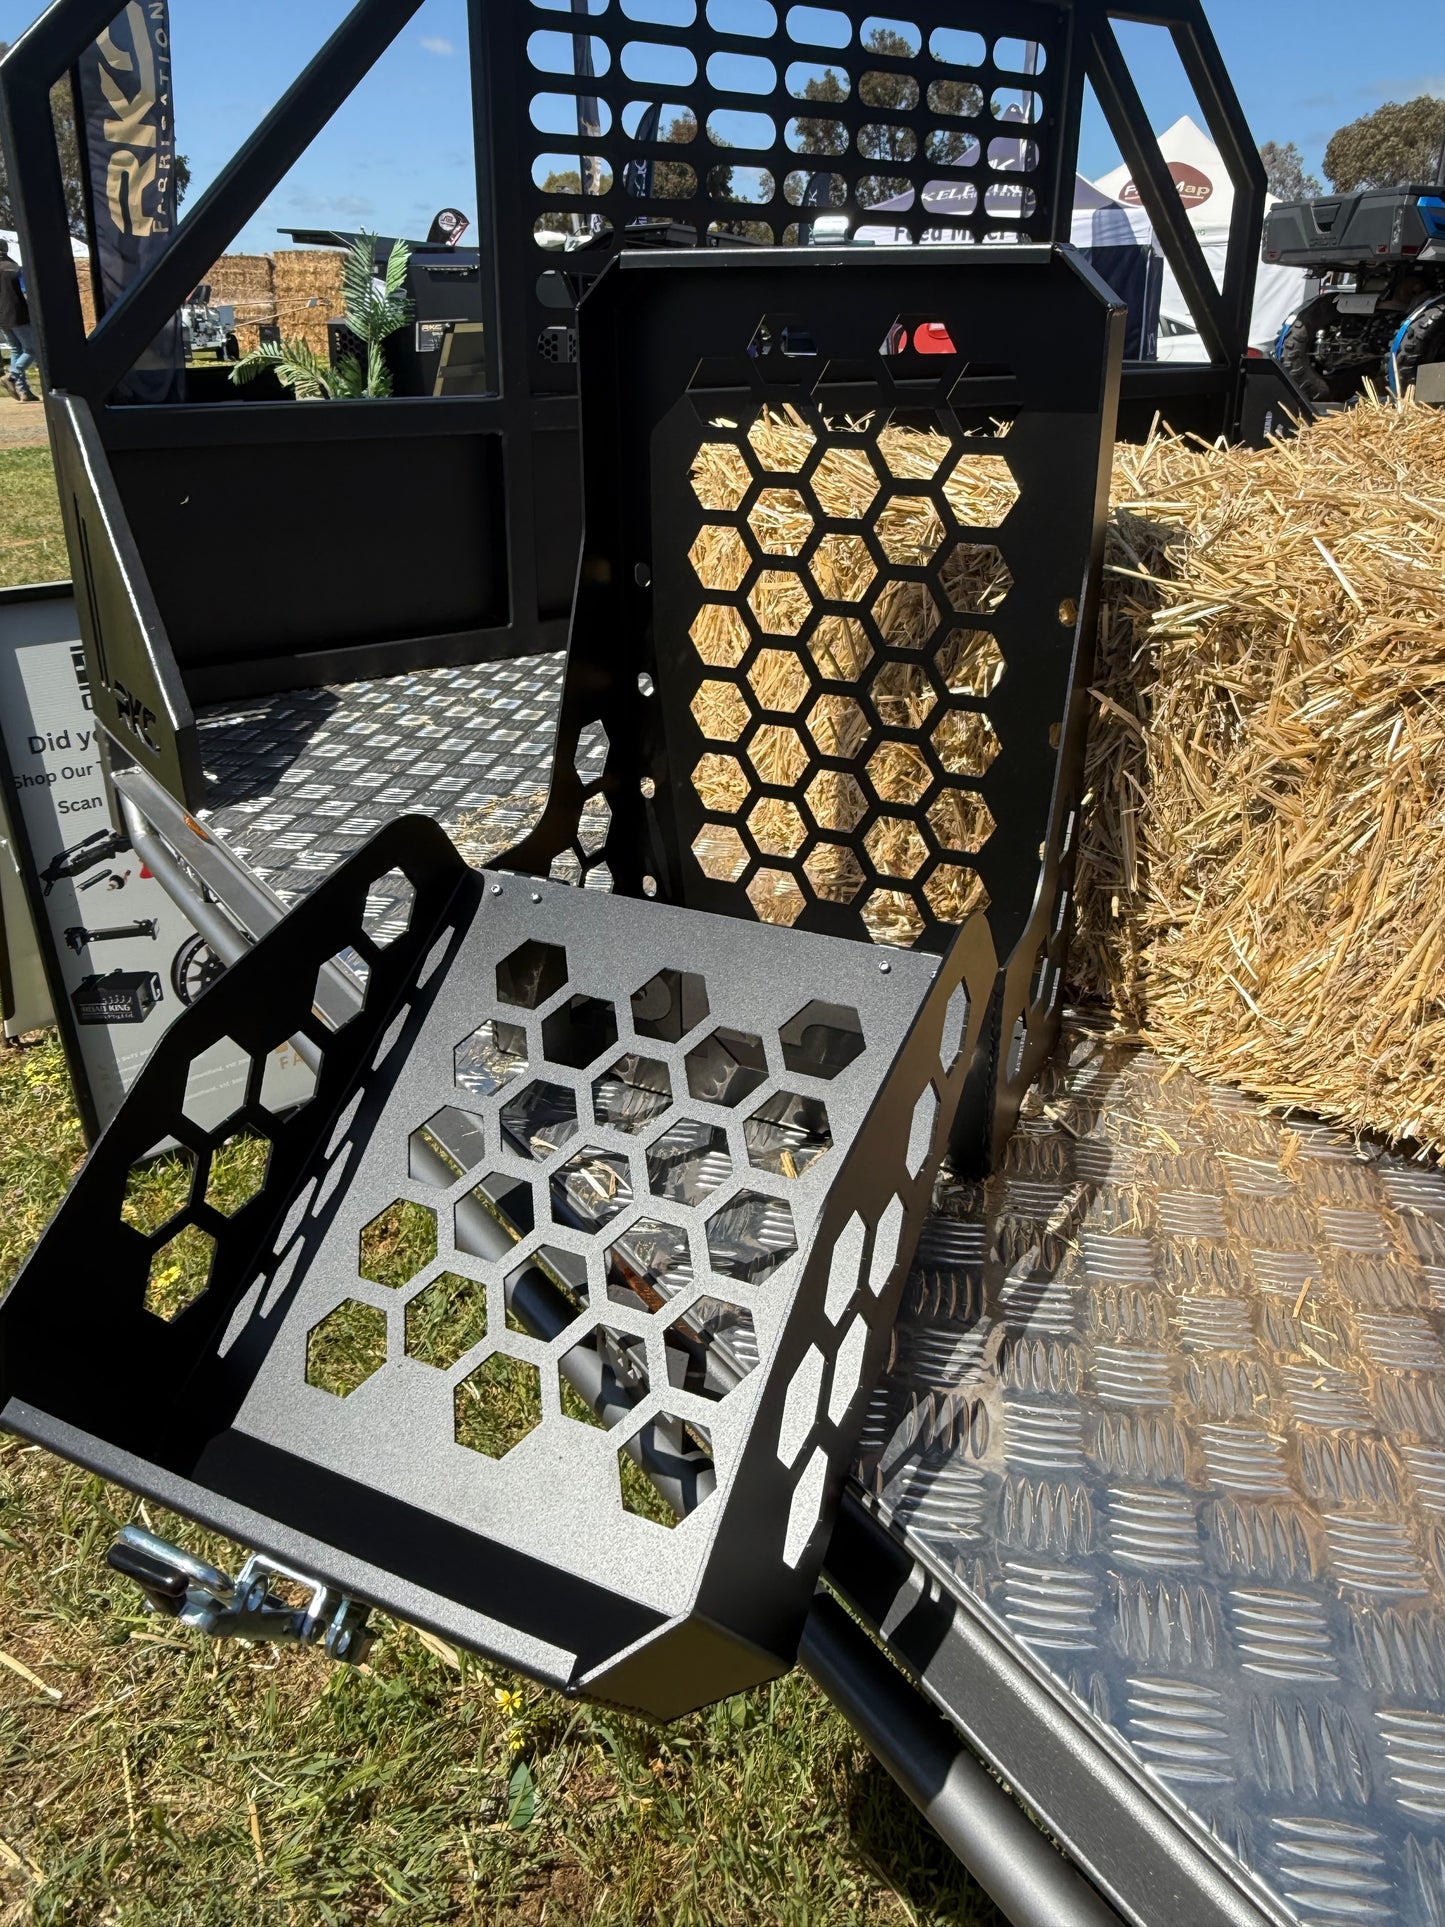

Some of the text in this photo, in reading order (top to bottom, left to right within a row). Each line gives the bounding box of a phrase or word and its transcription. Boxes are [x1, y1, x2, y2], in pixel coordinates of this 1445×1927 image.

[28, 729, 72, 755] Did
[12, 764, 94, 790] Shop Our
[57, 796, 103, 814] Scan
